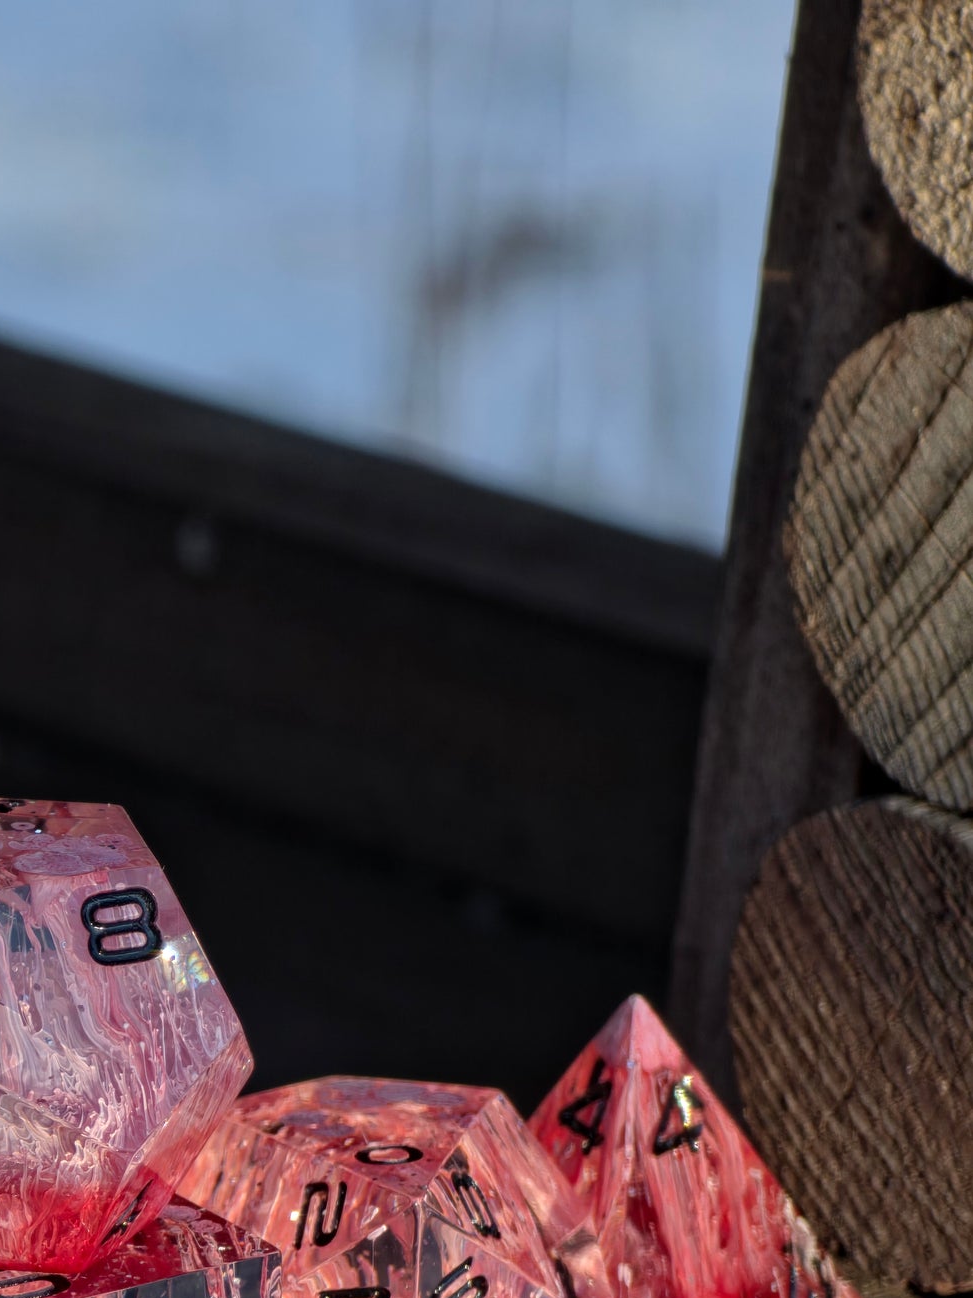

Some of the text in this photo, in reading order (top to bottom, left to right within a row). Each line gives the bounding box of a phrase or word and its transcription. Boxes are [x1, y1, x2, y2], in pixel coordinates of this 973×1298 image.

[82, 887, 164, 966] 8
[559, 1059, 612, 1155] 4
[653, 1075, 703, 1155] 4
[355, 1145, 423, 1165] 0
[295, 1181, 348, 1250] 2
